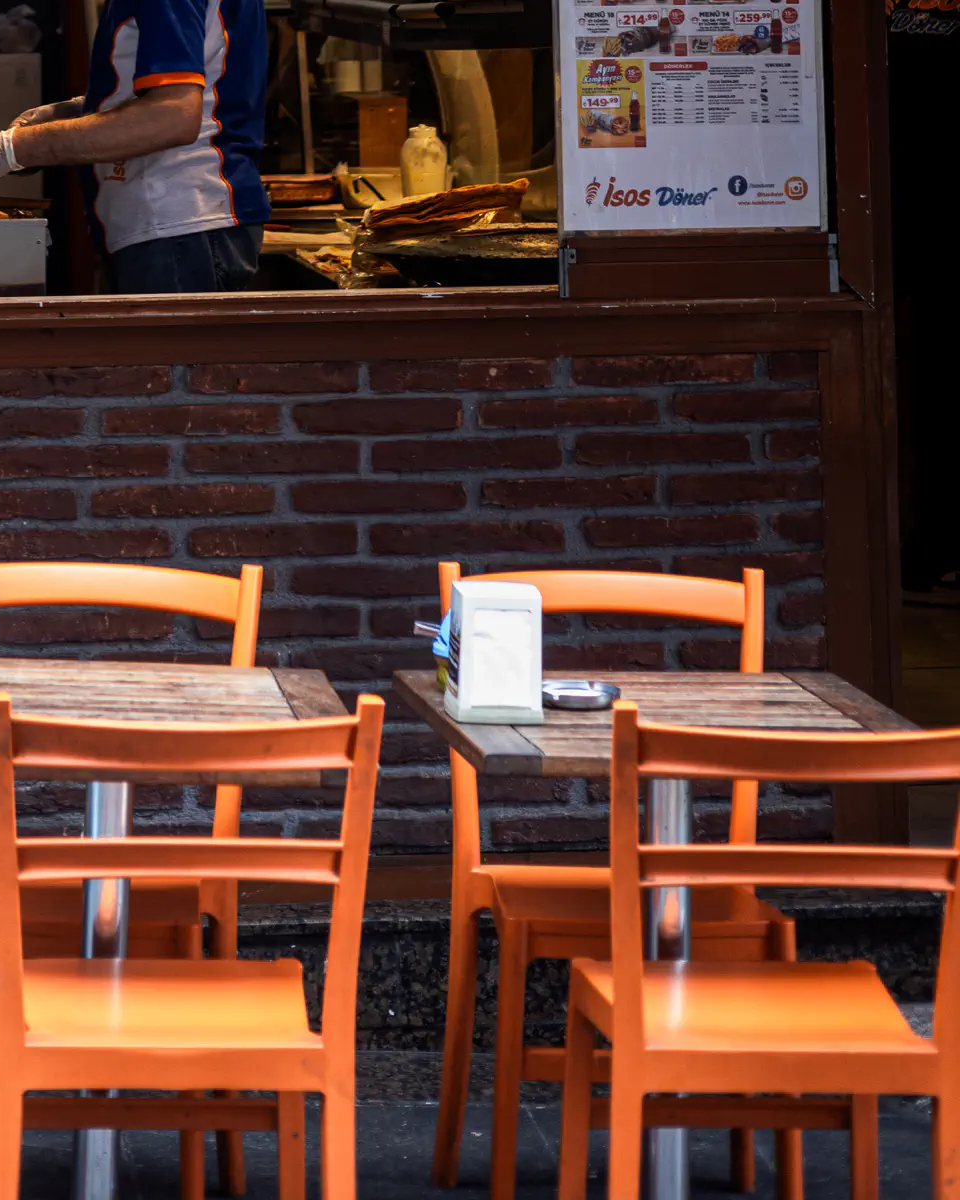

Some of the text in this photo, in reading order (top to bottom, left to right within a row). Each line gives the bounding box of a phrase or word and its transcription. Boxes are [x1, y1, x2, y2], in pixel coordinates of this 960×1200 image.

[596, 64, 616, 75] Ayın
[603, 176, 718, 207] İsos Döner
